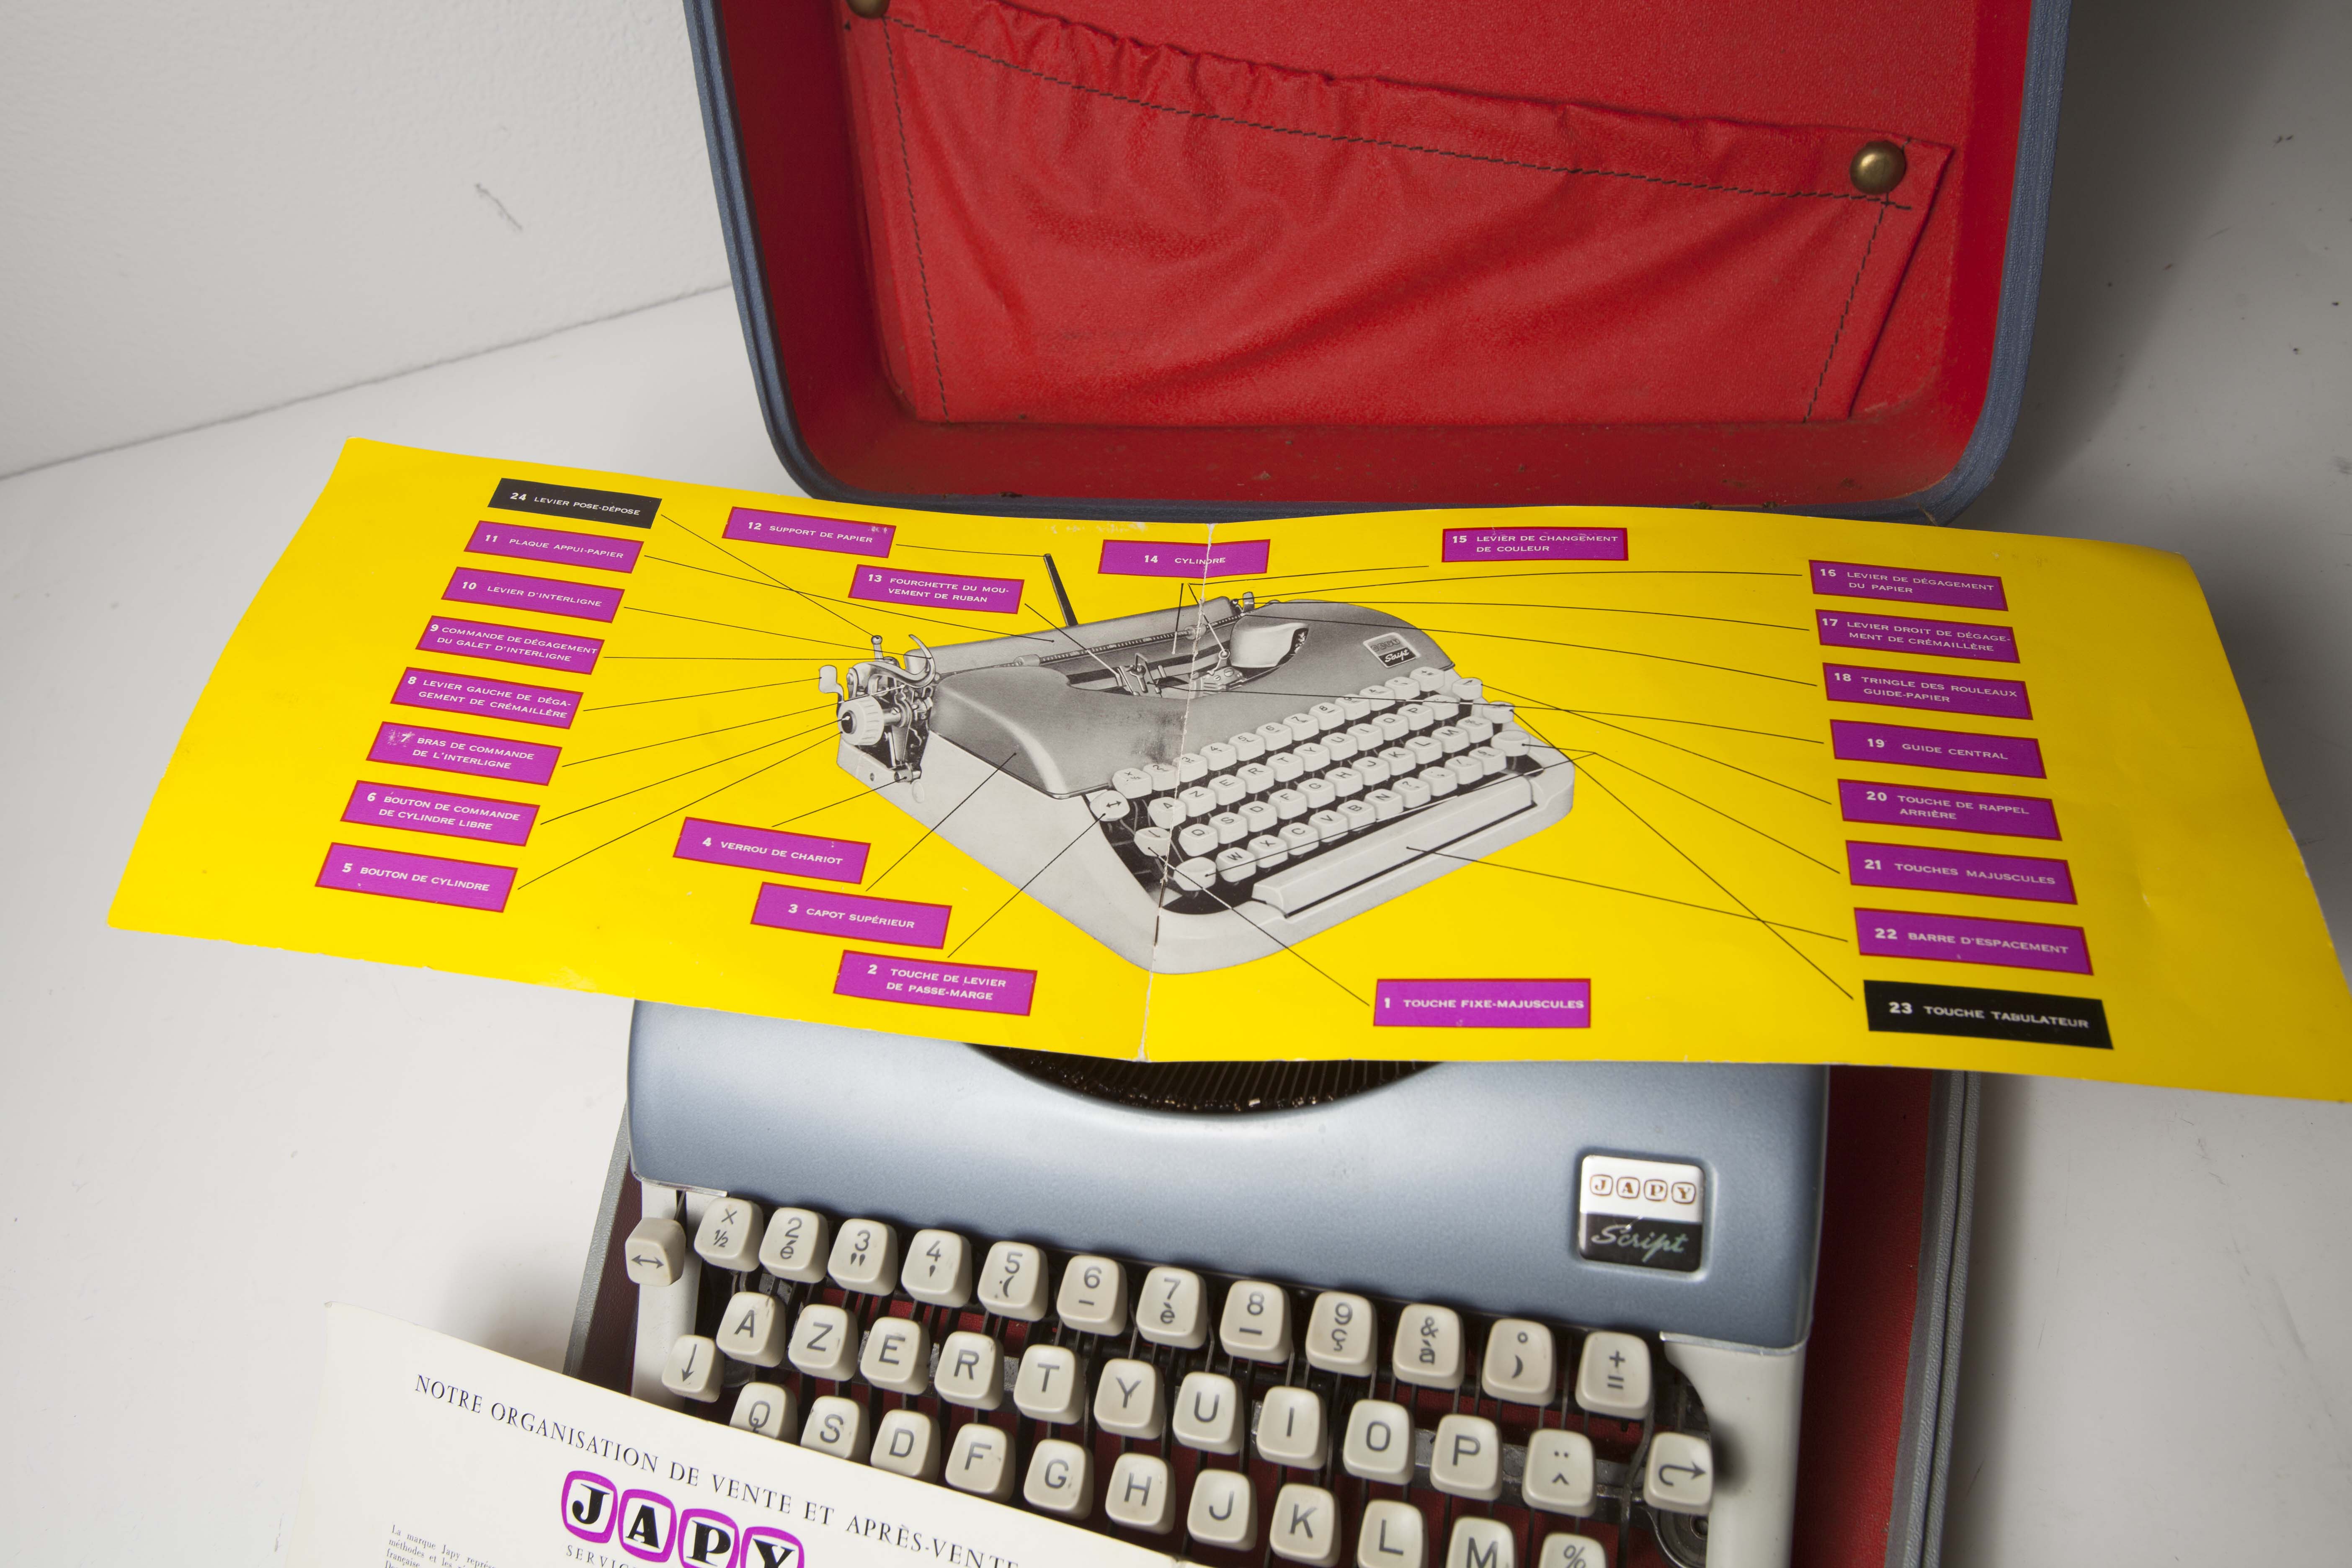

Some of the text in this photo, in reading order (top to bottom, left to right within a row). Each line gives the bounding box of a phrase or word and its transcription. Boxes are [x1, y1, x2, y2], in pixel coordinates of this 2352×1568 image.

[510, 492, 640, 515] 24 LEVIER POSE-DÉPOSE
[748, 522, 762, 530] 12
[769, 526, 816, 536] SUPPORT
[837, 534, 873, 543] PAPIER
[509, 539, 549, 548] PLAQUE
[553, 544, 624, 558] APPUI-PAPIER
[1145, 555, 1158, 563] 14
[869, 574, 882, 583] 13
[890, 578, 959, 590] FOURCHETTE
[888, 588, 931, 597] VEMENT
[1820, 568, 1836, 577] 16
[1847, 572, 1888, 580] LEVIER
[1913, 578, 1994, 591] DÉGAGEMENT
[1872, 584, 1913, 593] PAPIER
[462, 581, 602, 606] 10 LEVIER D'INTERLIGNE
[442, 627, 505, 640] COMMANDE
[524, 639, 597, 654] DÉGAGEMENT
[1823, 618, 1838, 627] 17
[1847, 622, 1889, 631] LEVIER
[1894, 626, 1931, 634] DROIT
[1957, 632, 2010, 641] DÉGAGE-
[1849, 632, 1883, 640] MENT
[1908, 638, 1994, 651] CRÉMAILLÈRE
[456, 640, 492, 649] GALET
[495, 645, 572, 662] D'INTERLIGNE
[408, 676, 417, 685] 8
[423, 680, 462, 691] LEVIER
[467, 686, 513, 698] GAUCHE
[537, 696, 571, 707] DÉGA-
[1834, 673, 1852, 682] 18
[1861, 677, 1916, 687] TRINGLE
[1951, 685, 2017, 697] ROULEAUX
[1863, 688, 1950, 702] GUIDE-PAPIER
[418, 691, 466, 703] GEMENT
[490, 701, 567, 718] CRÉMAILLÈRE
[400, 733, 408, 742] 7
[417, 738, 446, 747] BRAS
[469, 745, 534, 760] COMMANDE
[1867, 738, 2008, 760] 19 GUIDE CENTRAL
[433, 752, 512, 769] L'INTERLIGNE
[367, 792, 521, 820] 6 BOUTON DE COMMANDE
[1866, 791, 1887, 802] 20
[1897, 795, 1951, 807] TOUCHE
[1979, 804, 2029, 814] RAPPEL
[1900, 808, 1957, 820] ARRIÈRE
[398, 811, 456, 825] CYLINDRE
[459, 820, 493, 830] LIBRE
[702, 837, 843, 864] 4 VERROU DE CHARIOT
[342, 862, 490, 891] 5 BOUTON DE CYLINDRE
[1864, 859, 2055, 885] 21 TOUCHES MAJUSCULES
[788, 903, 915, 928] 3 CAPOT SUPÉRIEUR
[1875, 928, 2068, 953] 22 BARRE D'ESPACEMENT
[867, 964, 1006, 987] 2 TOUCHE DE LEVIER
[886, 982, 993, 1000] DE PASSE-MARGE
[1384, 997, 1584, 1009] 1 TOUCHE FIXE-MAJUSCULES
[1889, 1001, 2089, 1028] 23 TOUCHE TABULATEUR
[1593, 1178, 1692, 1201] JAPY
[1591, 1225, 1689, 1262] Script
[734, 1310, 755, 1338] A
[807, 1323, 833, 1351] Z
[879, 1336, 905, 1365] E
[954, 1353, 979, 1380] R
[1037, 1364, 1060, 1393] T
[1116, 1377, 1141, 1408] Y
[1194, 1392, 1218, 1423] U
[820, 1414, 843, 1444] S
[1287, 1408, 1293, 1437] I
[415, 1375, 482, 1413] NOTRE
[492, 1403, 658, 1473] ORGANISATION
[670, 1462, 699, 1486] DE
[712, 1474, 792, 1514] VENTE
[805, 1501, 835, 1525] ET
[889, 1431, 914, 1457] D
[1366, 1422, 1390, 1452] O
[1453, 1435, 1480, 1466] P
[965, 1442, 992, 1470] F
[1044, 1460, 1069, 1489] G
[1124, 1472, 1152, 1506] H
[1209, 1491, 1235, 1521] J
[572, 1483, 795, 1568] JAPY
[1289, 1504, 1317, 1538] K
[389, 1539, 424, 1558] méthodes
[429, 1554, 437, 1563] et
[392, 1524, 401, 1536] La
[407, 1533, 436, 1549] marque
[442, 1545, 460, 1561] Japy
[1379, 1519, 1403, 1556] L
